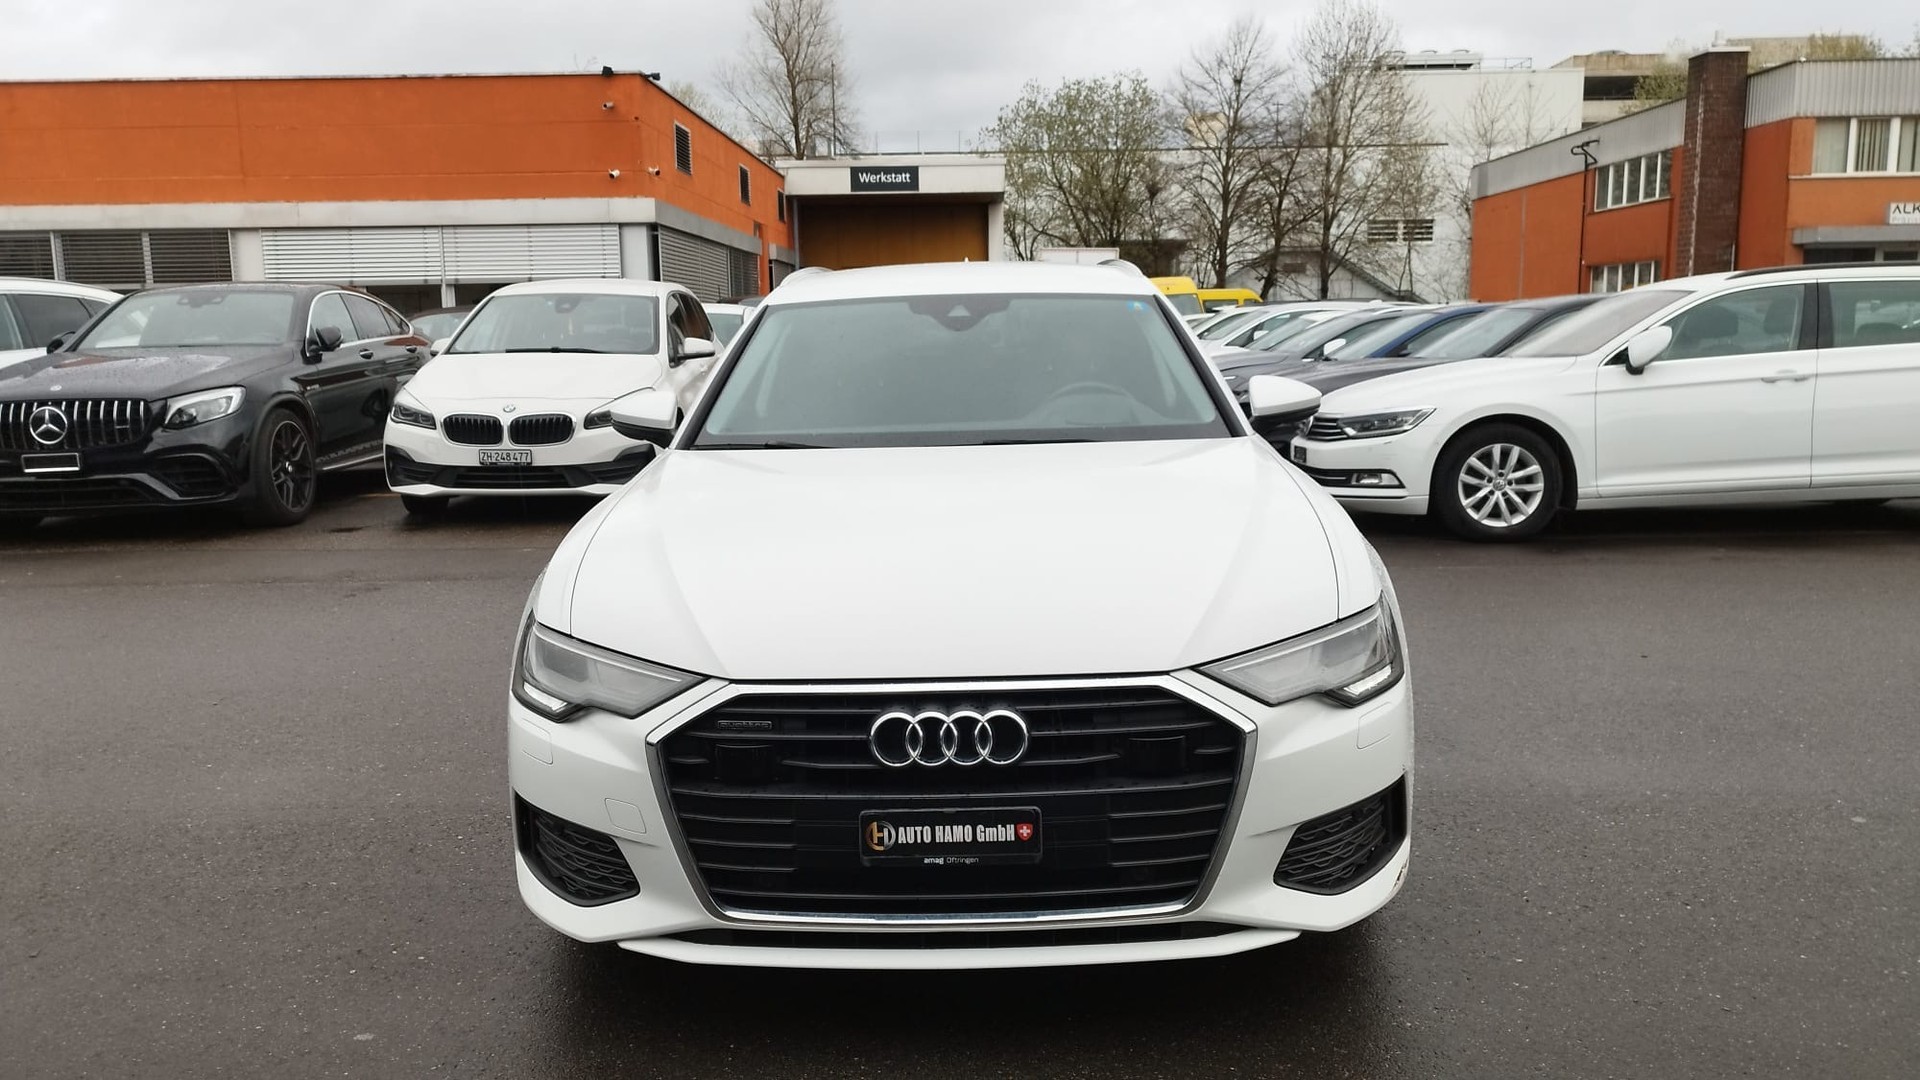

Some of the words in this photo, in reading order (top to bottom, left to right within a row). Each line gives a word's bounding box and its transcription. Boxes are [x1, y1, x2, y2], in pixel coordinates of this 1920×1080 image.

[858, 171, 911, 183] Werkstatt
[898, 826, 932, 844] AUTO
[935, 824, 973, 843] HAMO
[976, 824, 1016, 842] GmbH
[923, 857, 945, 865] amag
[946, 856, 979, 865] Oftringen
